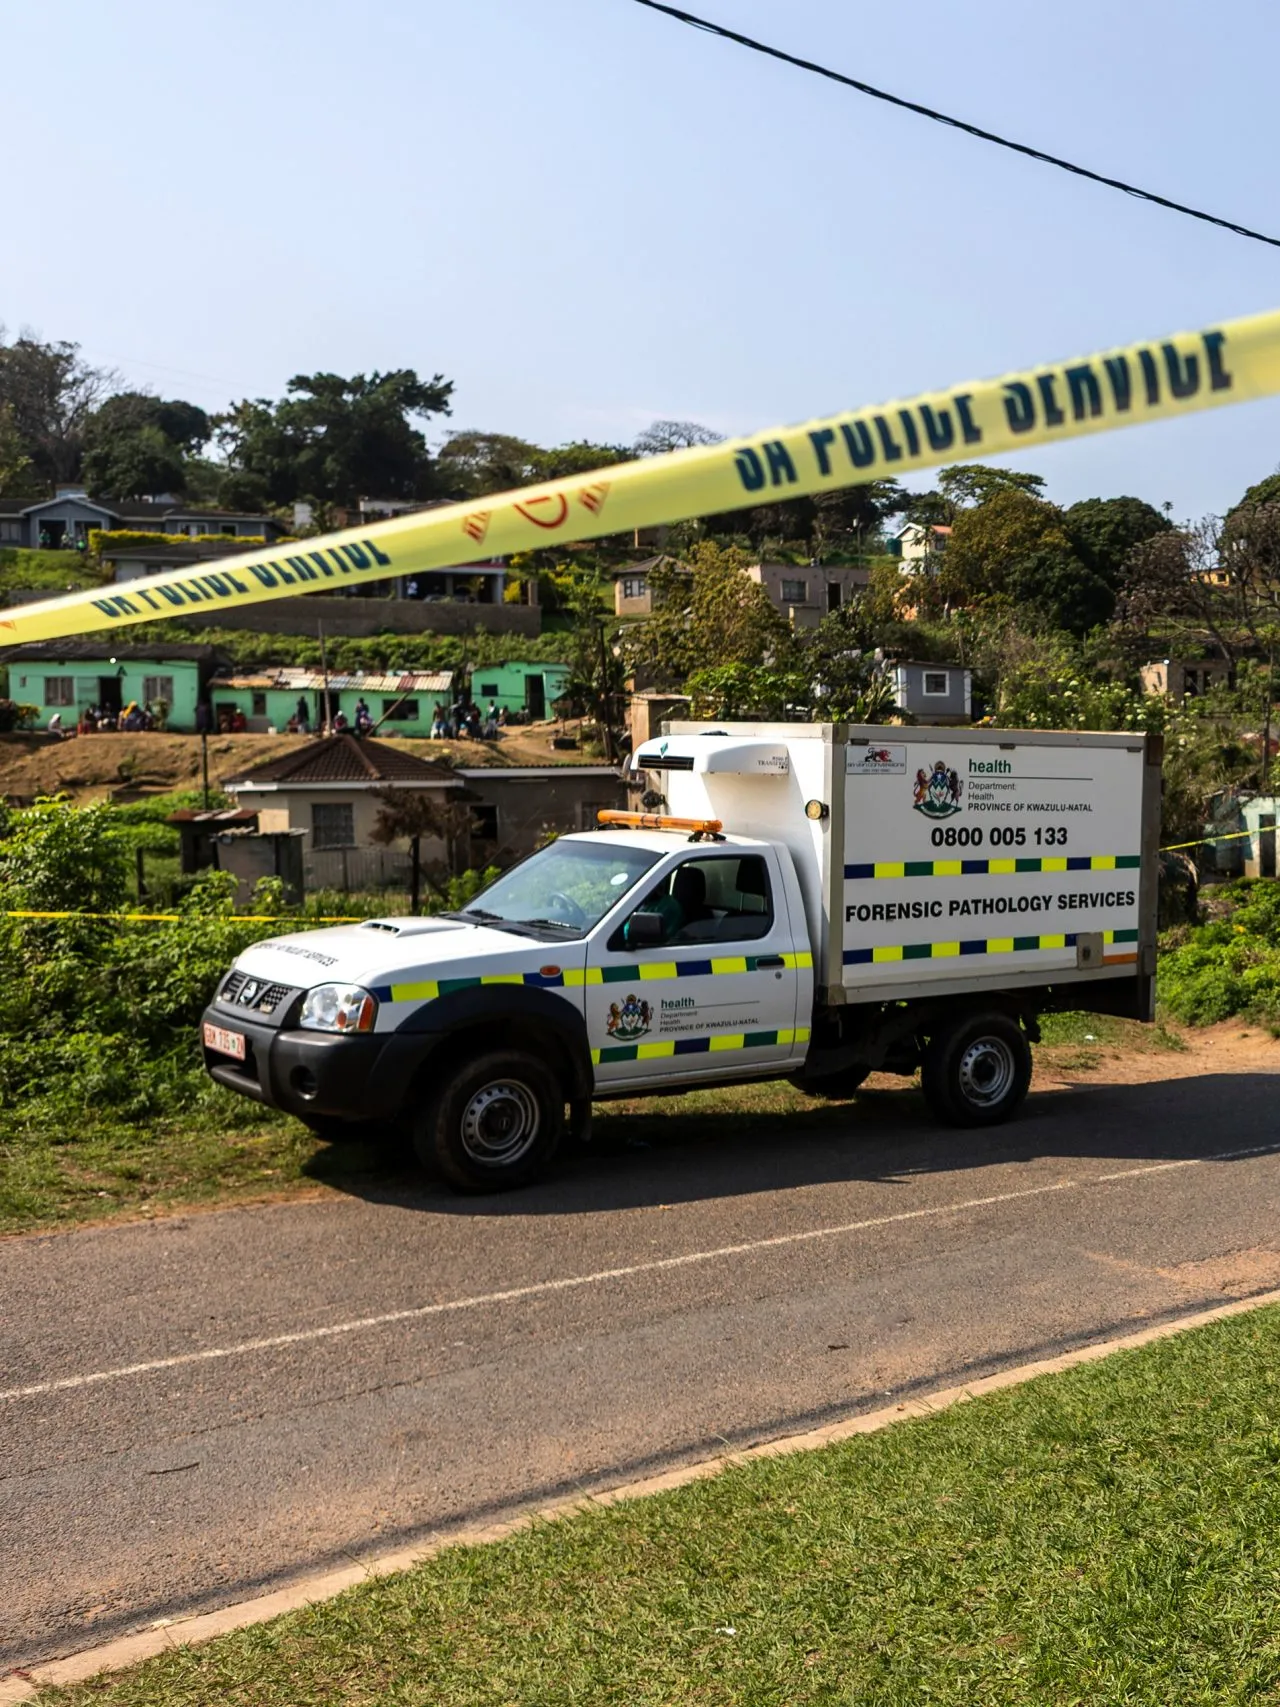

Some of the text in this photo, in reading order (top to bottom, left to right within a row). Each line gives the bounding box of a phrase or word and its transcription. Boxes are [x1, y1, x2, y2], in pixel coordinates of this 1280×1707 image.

[968, 758, 1012, 774] health
[968, 792, 995, 801] Health
[967, 802, 1094, 813] PROVINCE OF KWAZULU-NATAL
[931, 827, 1069, 847] 0800 005 133
[845, 890, 1136, 923] FORENSIC PATHOLOGY SERVICES
[660, 997, 696, 1010] health
[659, 1018, 760, 1034] PROVINCE OF KWAZULU-NATAL
[660, 1018, 681, 1026] Health
